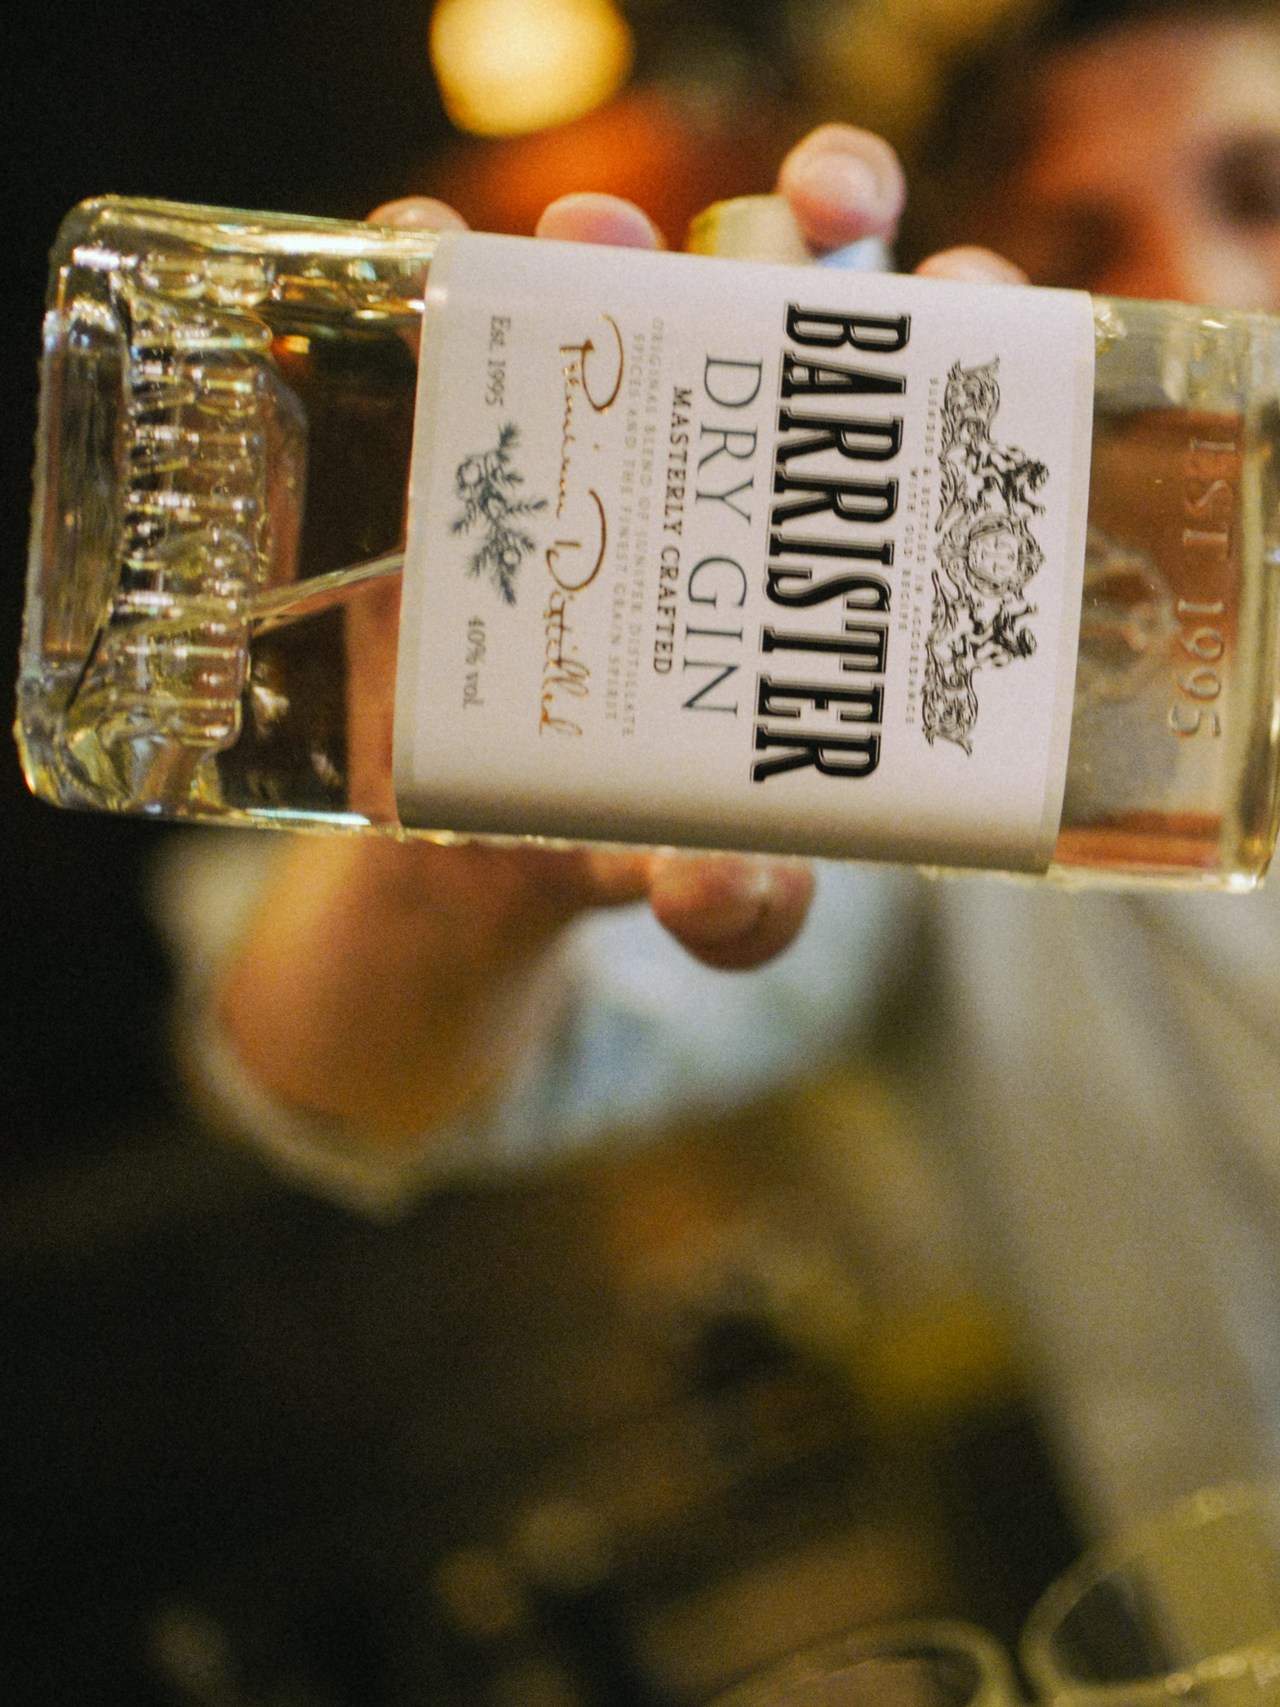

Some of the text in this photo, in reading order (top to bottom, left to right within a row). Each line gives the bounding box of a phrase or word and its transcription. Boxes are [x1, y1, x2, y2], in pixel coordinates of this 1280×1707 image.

[484, 359, 507, 407] 1995
[538, 313, 625, 738] Premium Distilled
[465, 616, 487, 666] 40%
[652, 386, 693, 676] MASTERLY CRAFTED
[681, 354, 764, 716] DRY GIN
[750, 303, 912, 785] BARRISTER
[1167, 598, 1228, 740] 1995
